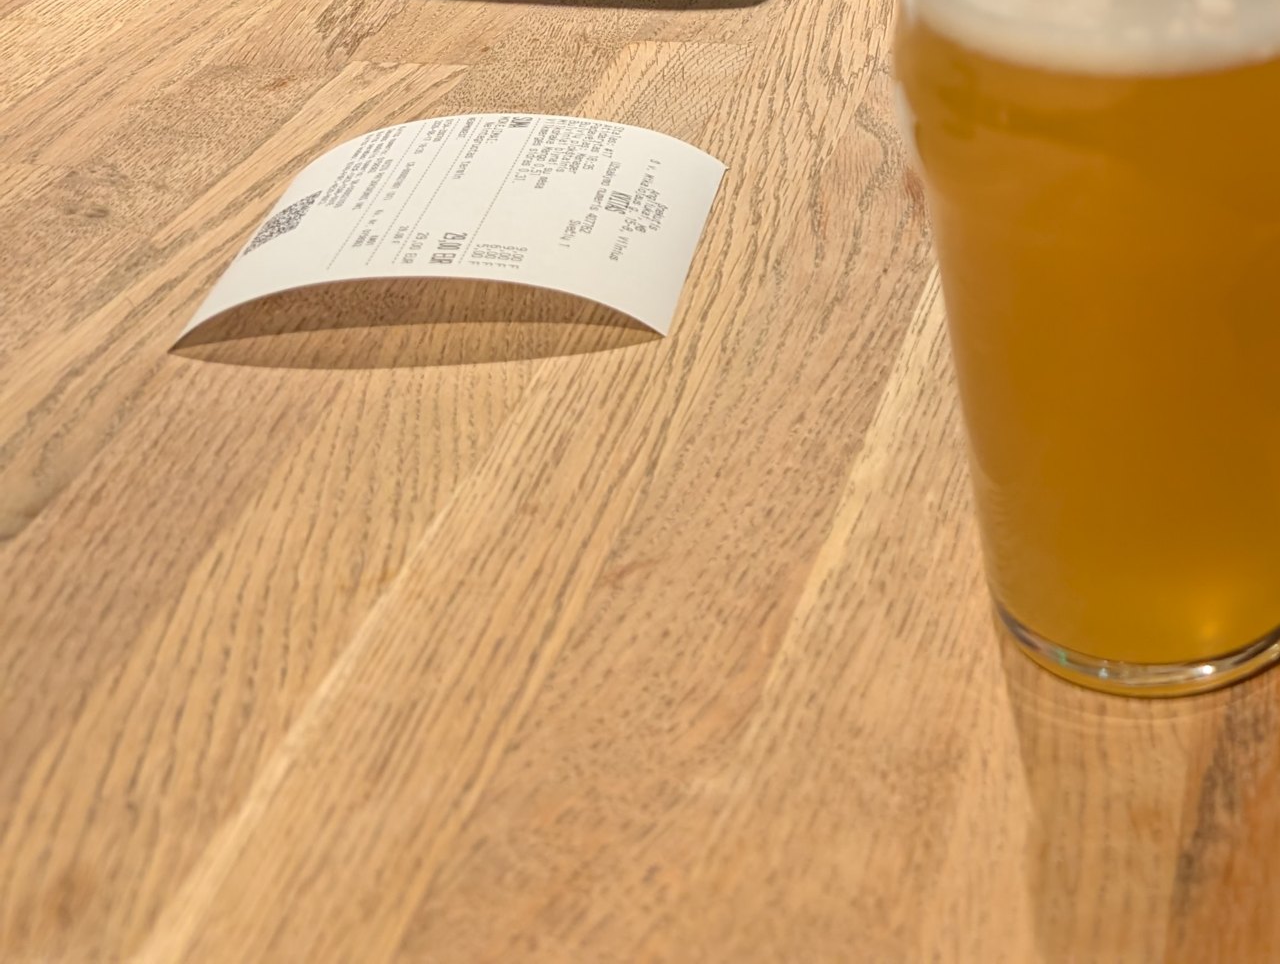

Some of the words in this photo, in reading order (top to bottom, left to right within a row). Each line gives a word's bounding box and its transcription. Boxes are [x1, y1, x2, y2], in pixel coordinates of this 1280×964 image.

[604, 190, 632, 214] KVITAS
[436, 231, 467, 250] 29,00
[428, 252, 456, 264] EUR
